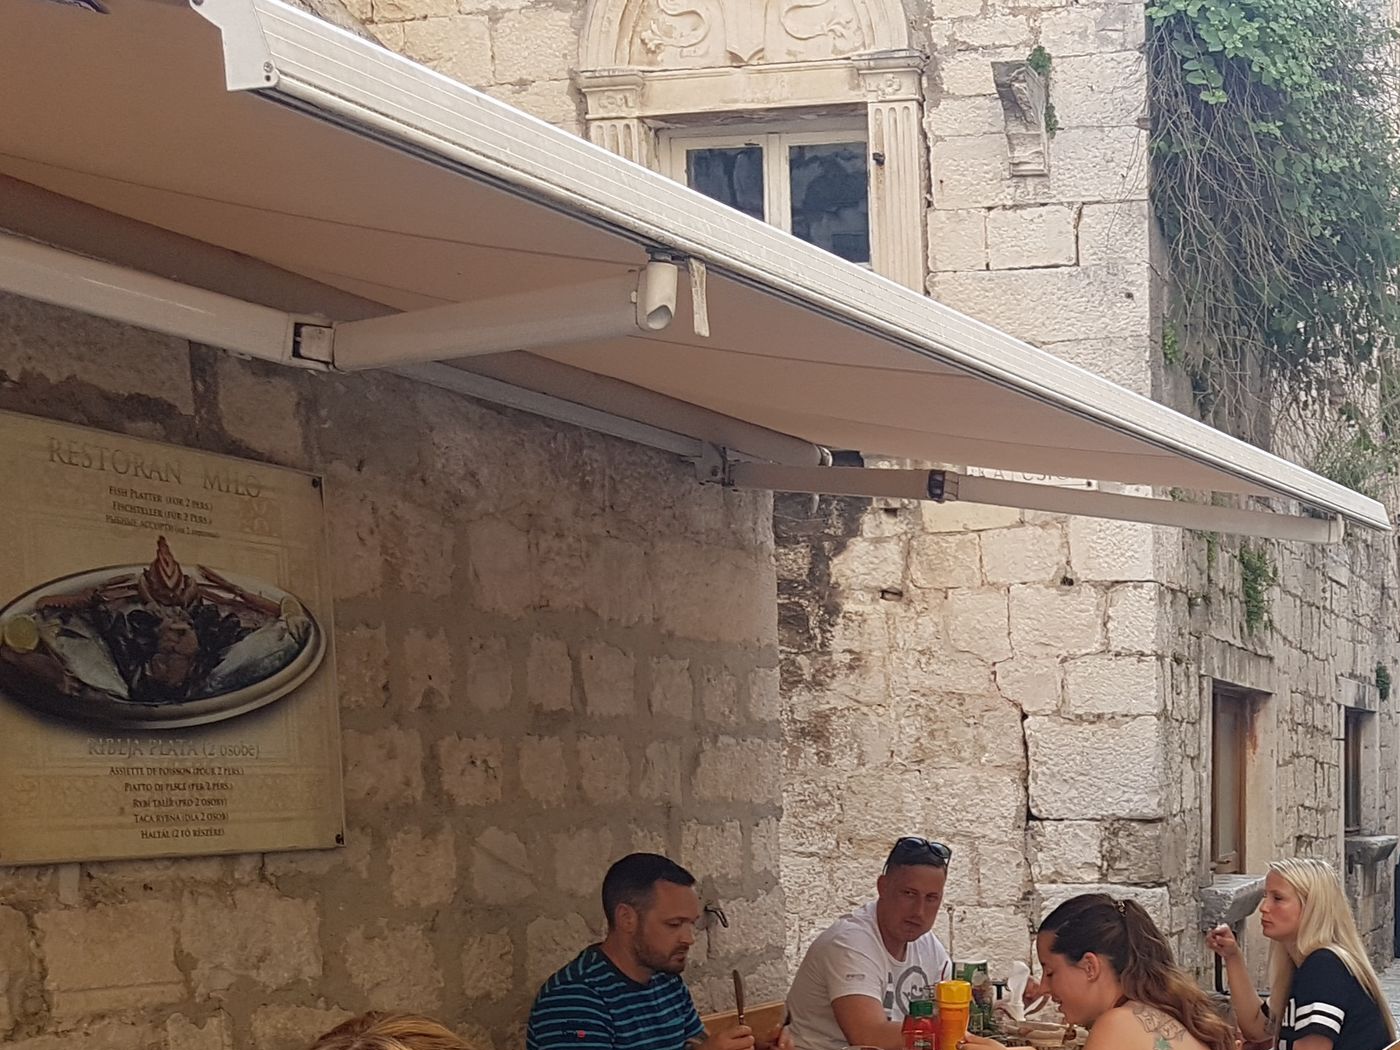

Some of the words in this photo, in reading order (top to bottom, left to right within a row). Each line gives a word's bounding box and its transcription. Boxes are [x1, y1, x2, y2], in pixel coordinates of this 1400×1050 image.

[48, 436, 182, 485] RESTORAN
[201, 464, 262, 497] MILO
[109, 486, 129, 497] FISH
[130, 489, 163, 502] PLATTER
[185, 497, 191, 508] 2
[183, 512, 189, 521] 2
[88, 735, 143, 758] RIBLJA
[148, 736, 198, 757] PLATA
[109, 766, 145, 776] ASSIETTE
[158, 767, 192, 776] POISSON
[217, 766, 223, 776] 2
[124, 782, 152, 792] PIATTO
[153, 782, 165, 792] DI
[205, 781, 211, 791] 2
[133, 814, 155, 823] TACA
